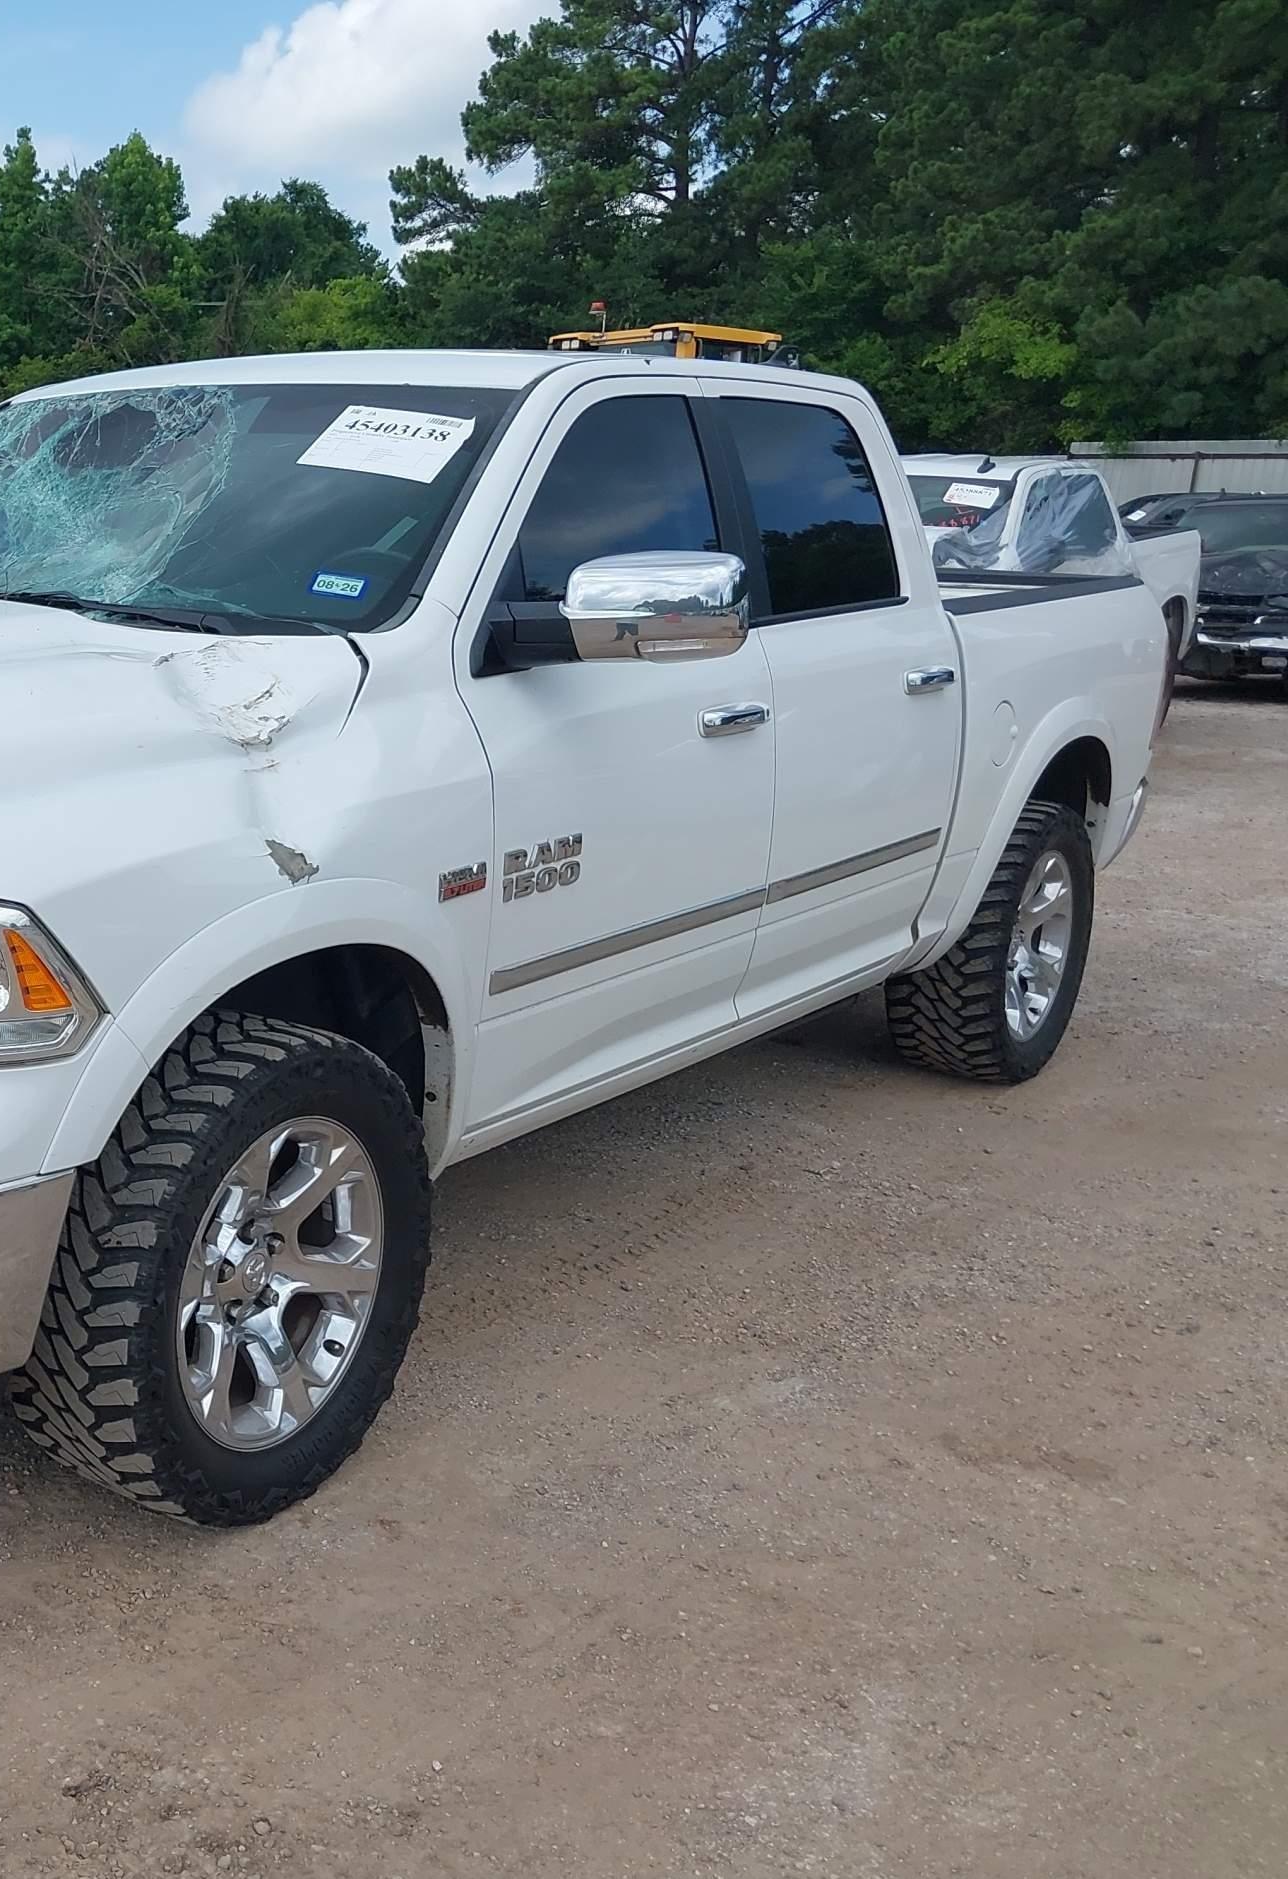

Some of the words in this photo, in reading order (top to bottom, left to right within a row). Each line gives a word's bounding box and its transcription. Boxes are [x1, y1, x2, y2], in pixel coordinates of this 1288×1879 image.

[344, 418, 451, 443] 45403138
[316, 579, 335, 590] 08
[340, 582, 359, 593] 26
[503, 832, 583, 877] RAM
[503, 860, 581, 904] 1500
